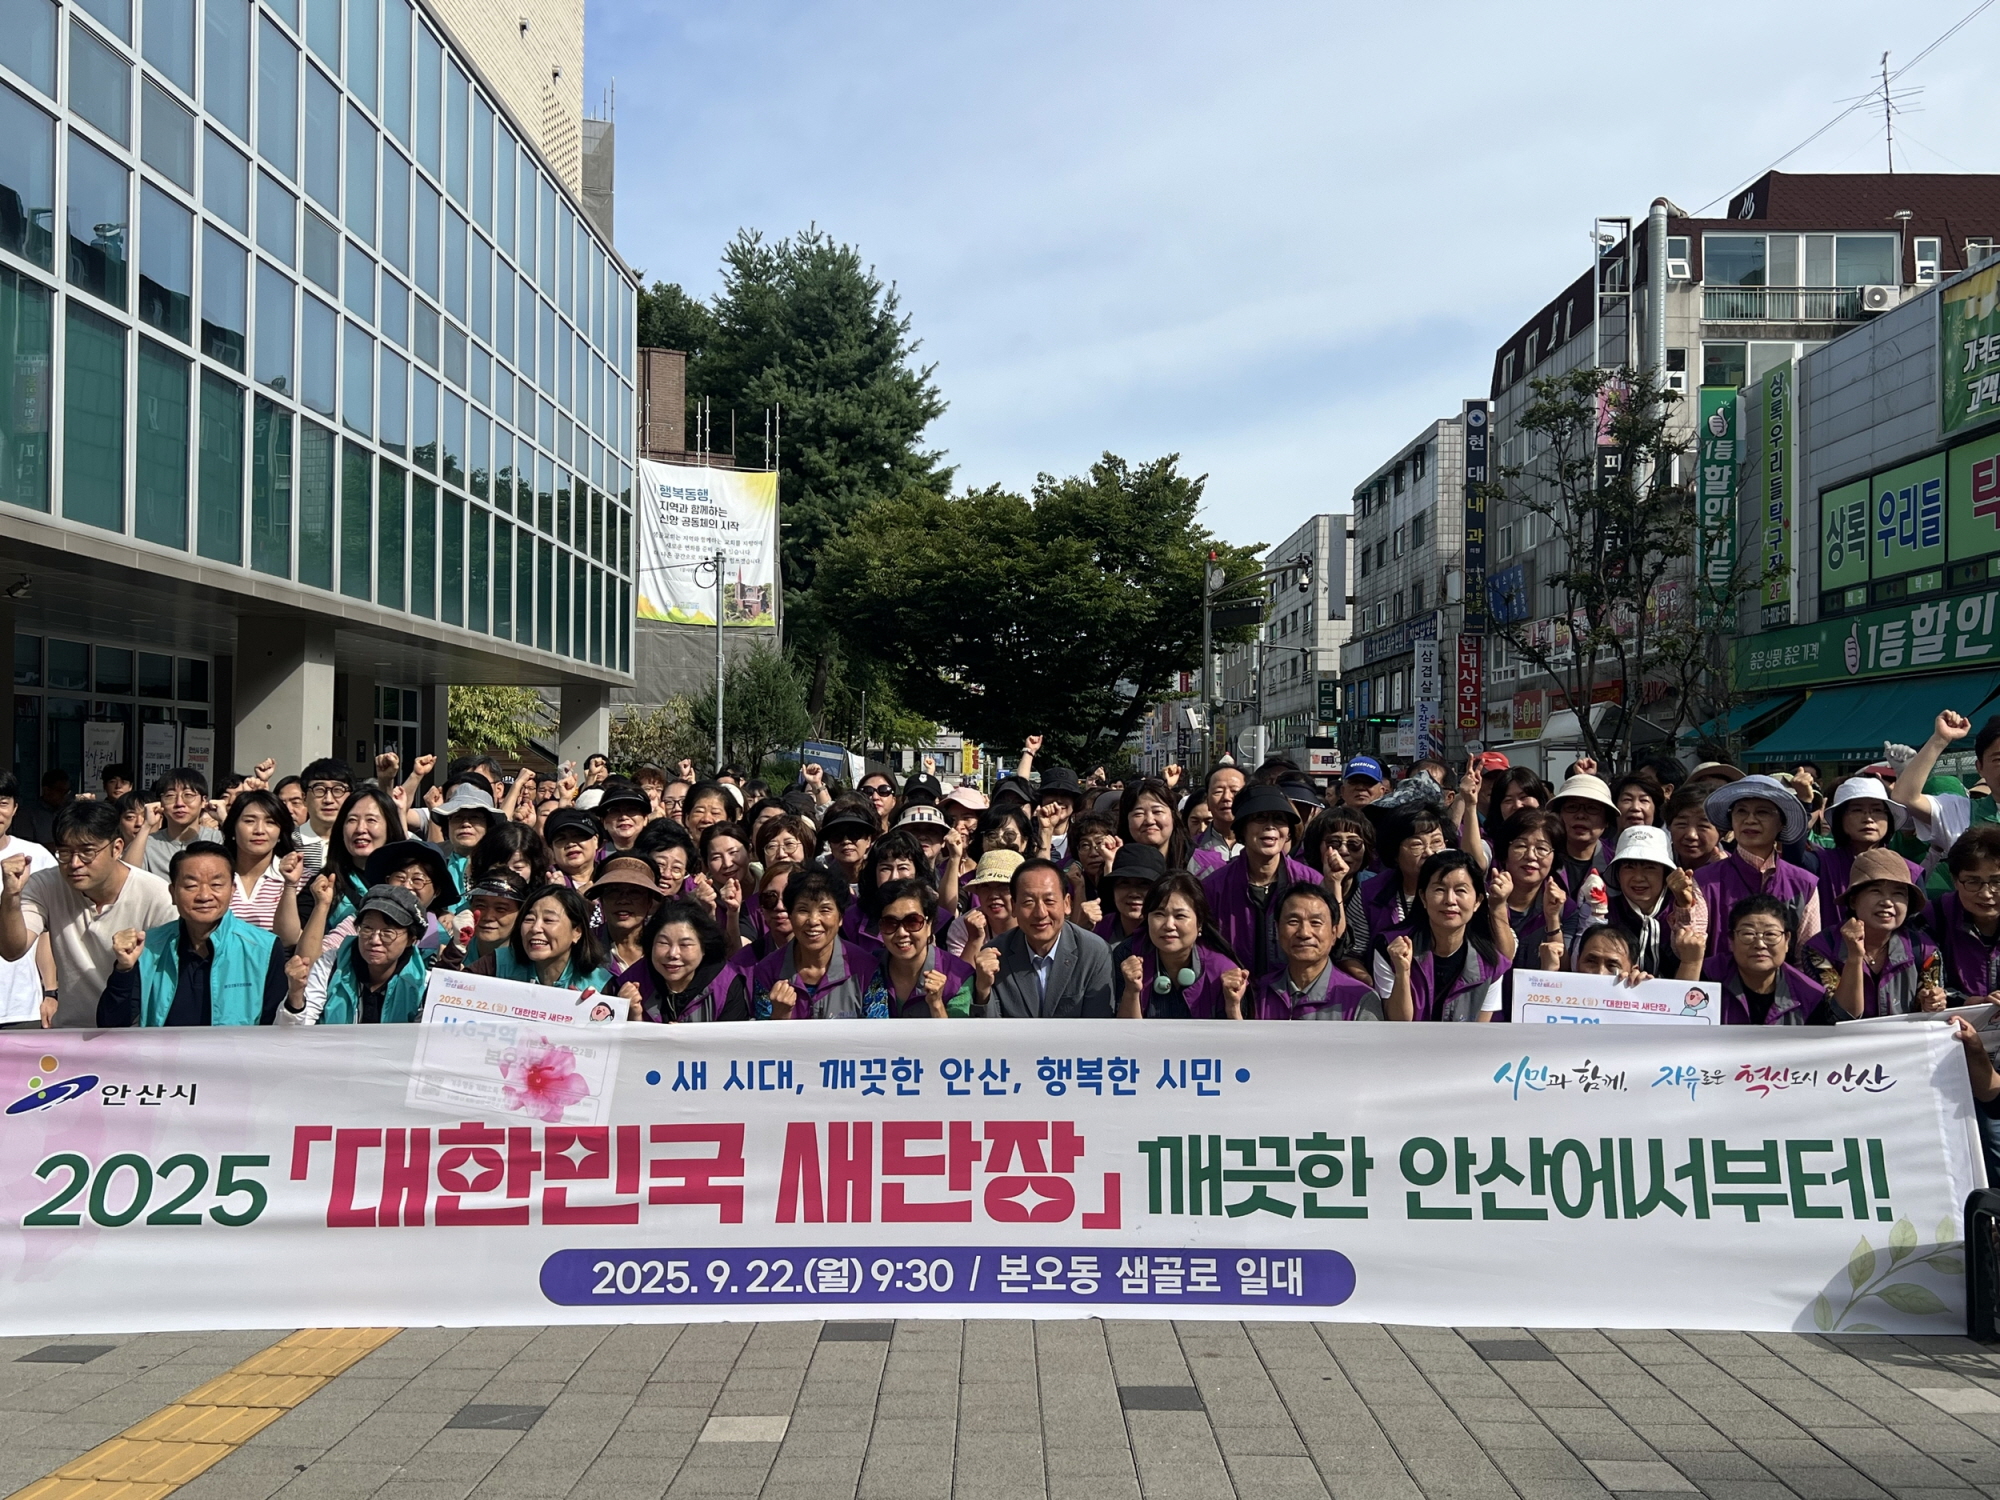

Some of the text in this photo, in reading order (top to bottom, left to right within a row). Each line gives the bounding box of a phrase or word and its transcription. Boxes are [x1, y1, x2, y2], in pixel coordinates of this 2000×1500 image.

[660, 484, 713, 504] 행복동행,
[660, 501, 728, 518] 지역과 함께하는
[682, 517, 718, 529] 공동체의
[721, 521, 740, 531] 시작
[1826, 500, 1866, 571] 상록
[1877, 477, 1942, 558] 우리들
[1769, 582, 1782, 601] 2F
[1868, 591, 1999, 669] 1등할인
[1421, 650, 1434, 694] 삼겹살
[1460, 636, 1478, 718] 현대사우나
[1418, 703, 1430, 732] 추자도
[439, 994, 463, 1006] 2025.
[466, 999, 477, 1008] 9.
[477, 1001, 490, 1010] 22.
[1527, 993, 1551, 1003] 2025.
[1555, 996, 1564, 1004] 9.
[1566, 996, 1580, 1005] 22.
[1602, 999, 1639, 1010] 「대한민국
[1641, 1001, 1671, 1013] 새단장」
[101, 1082, 197, 1107] 안산시
[671, 1056, 1223, 1097] 새 시대, 깨끗한 안산, 행복한 시민
[1493, 1055, 1572, 1101] 시민과
[1651, 1065, 1726, 1101] 자유로운
[1734, 1063, 1818, 1098] 혁신도시
[1827, 1062, 1898, 1093] 안산
[22, 1120, 1894, 1230] 2025 「대한민국 새단장」 깨끗한 안산에서부터!
[592, 1259, 697, 1296] 2025.
[706, 1259, 738, 1295] 9.
[870, 1257, 954, 1294] 9:30
[969, 1254, 981, 1294] /
[996, 1254, 1100, 1296] 본오동
[1115, 1254, 1221, 1296] 샘골로
[1236, 1254, 1305, 1298] 일대
